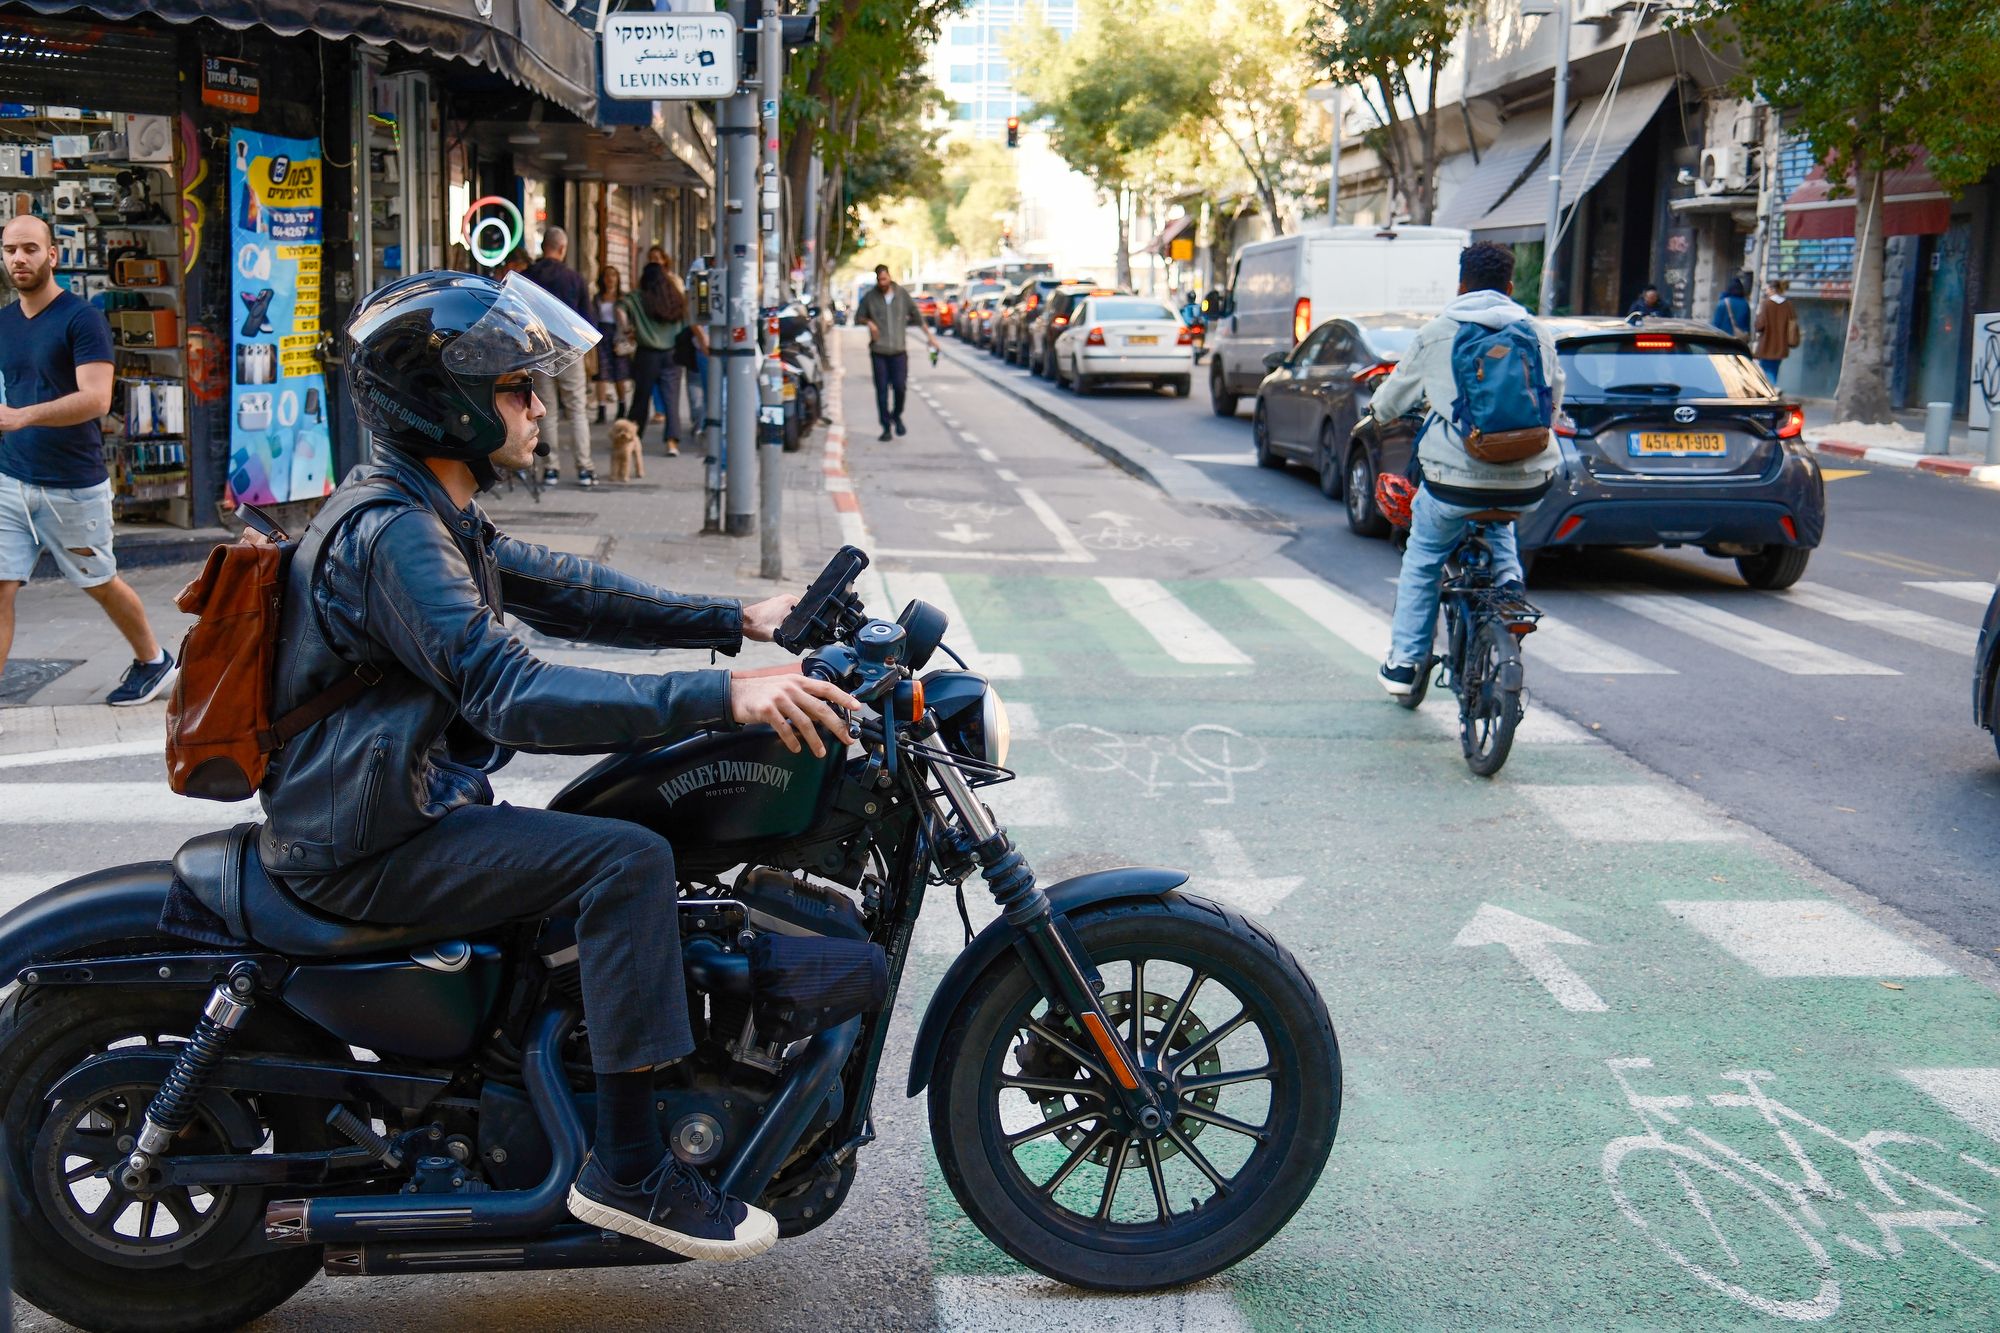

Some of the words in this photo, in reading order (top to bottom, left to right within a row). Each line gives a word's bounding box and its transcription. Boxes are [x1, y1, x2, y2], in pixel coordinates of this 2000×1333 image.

[615, 22, 674, 44] לוינסקי
[206, 58, 220, 70] 38
[620, 73, 701, 88] LEVINSKY
[367, 386, 445, 442] HARLEY-DAVIDSON
[705, 787, 734, 798] MOTOR
